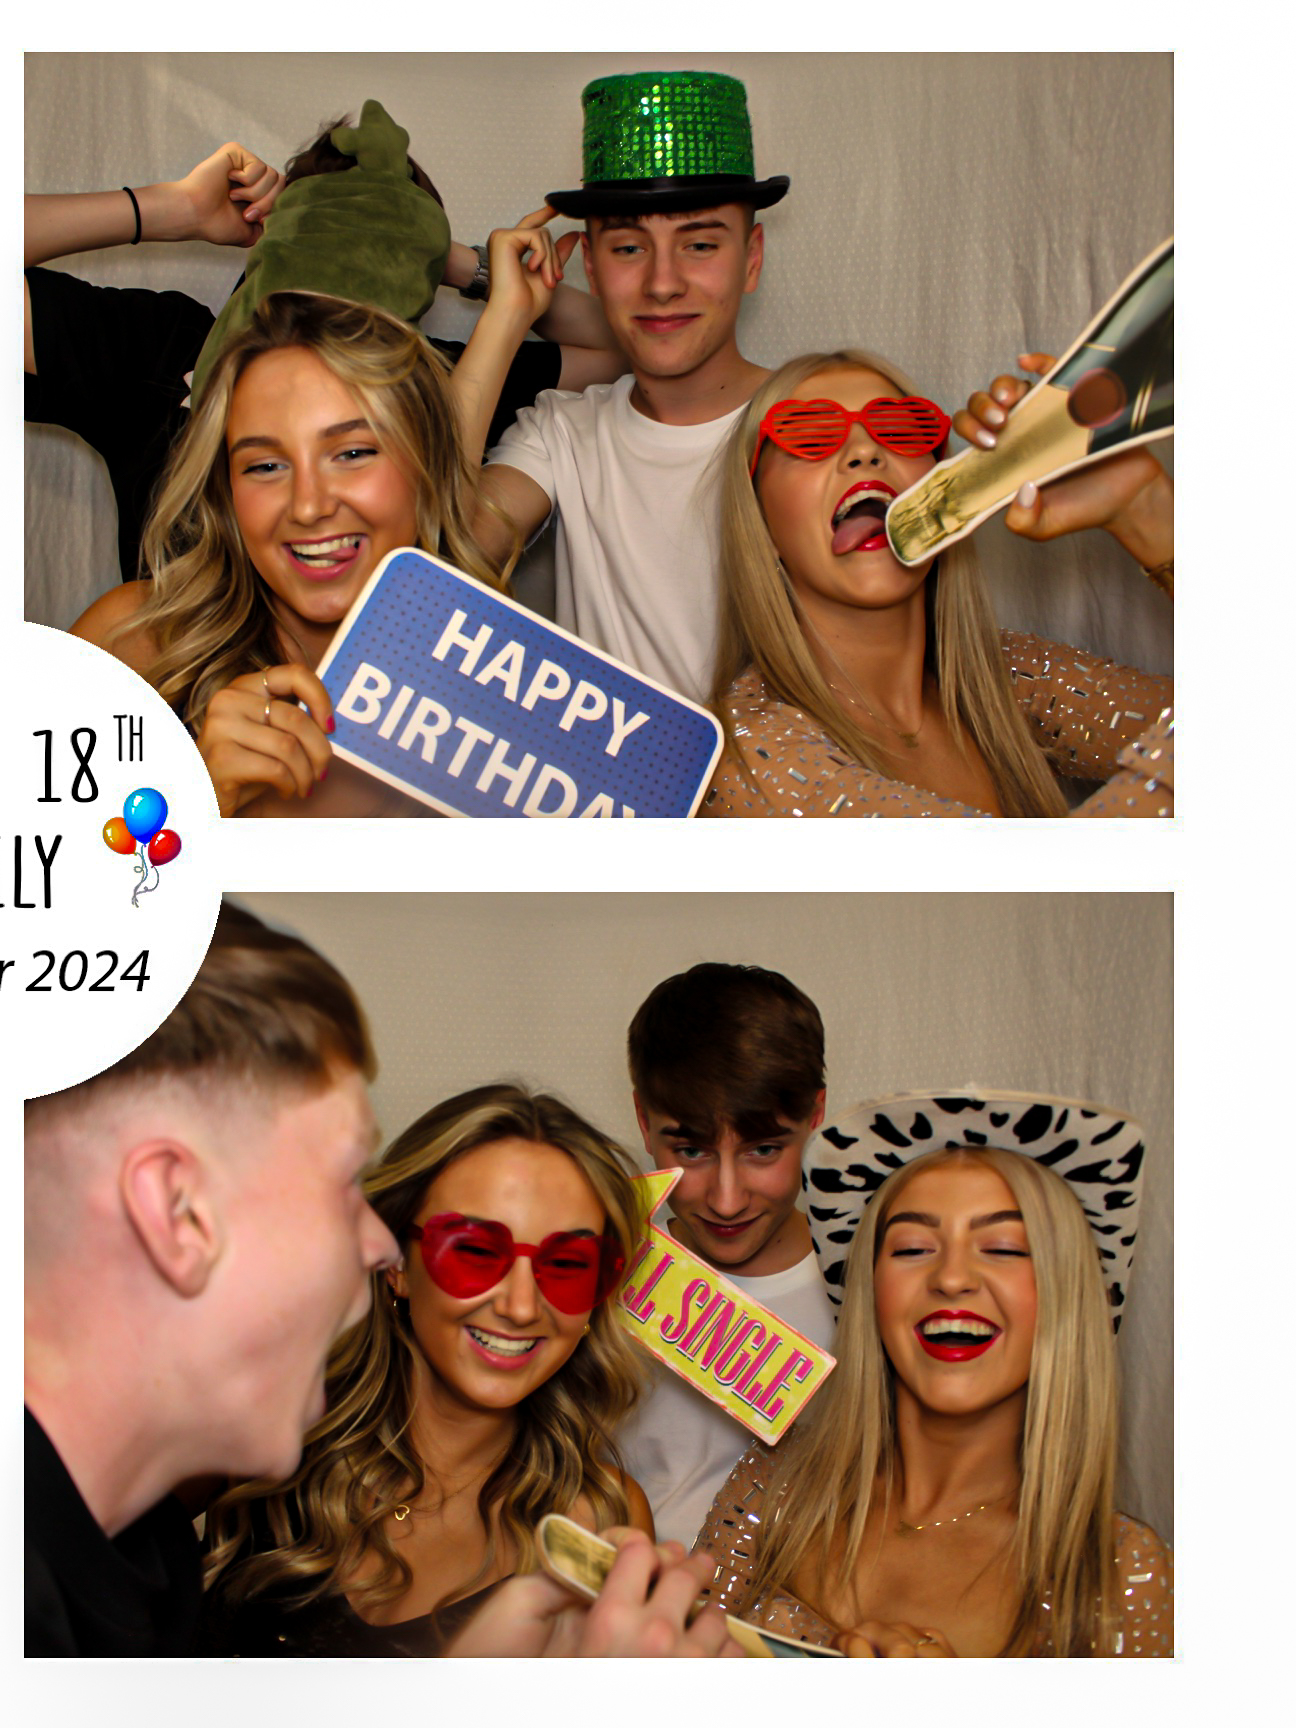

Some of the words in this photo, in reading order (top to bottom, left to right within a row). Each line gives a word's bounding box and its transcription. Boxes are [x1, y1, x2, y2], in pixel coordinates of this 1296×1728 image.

[336, 662, 636, 818] BIRTHDA
[432, 609, 650, 757] HAPPY
[659, 1278, 814, 1422] SINGLE
